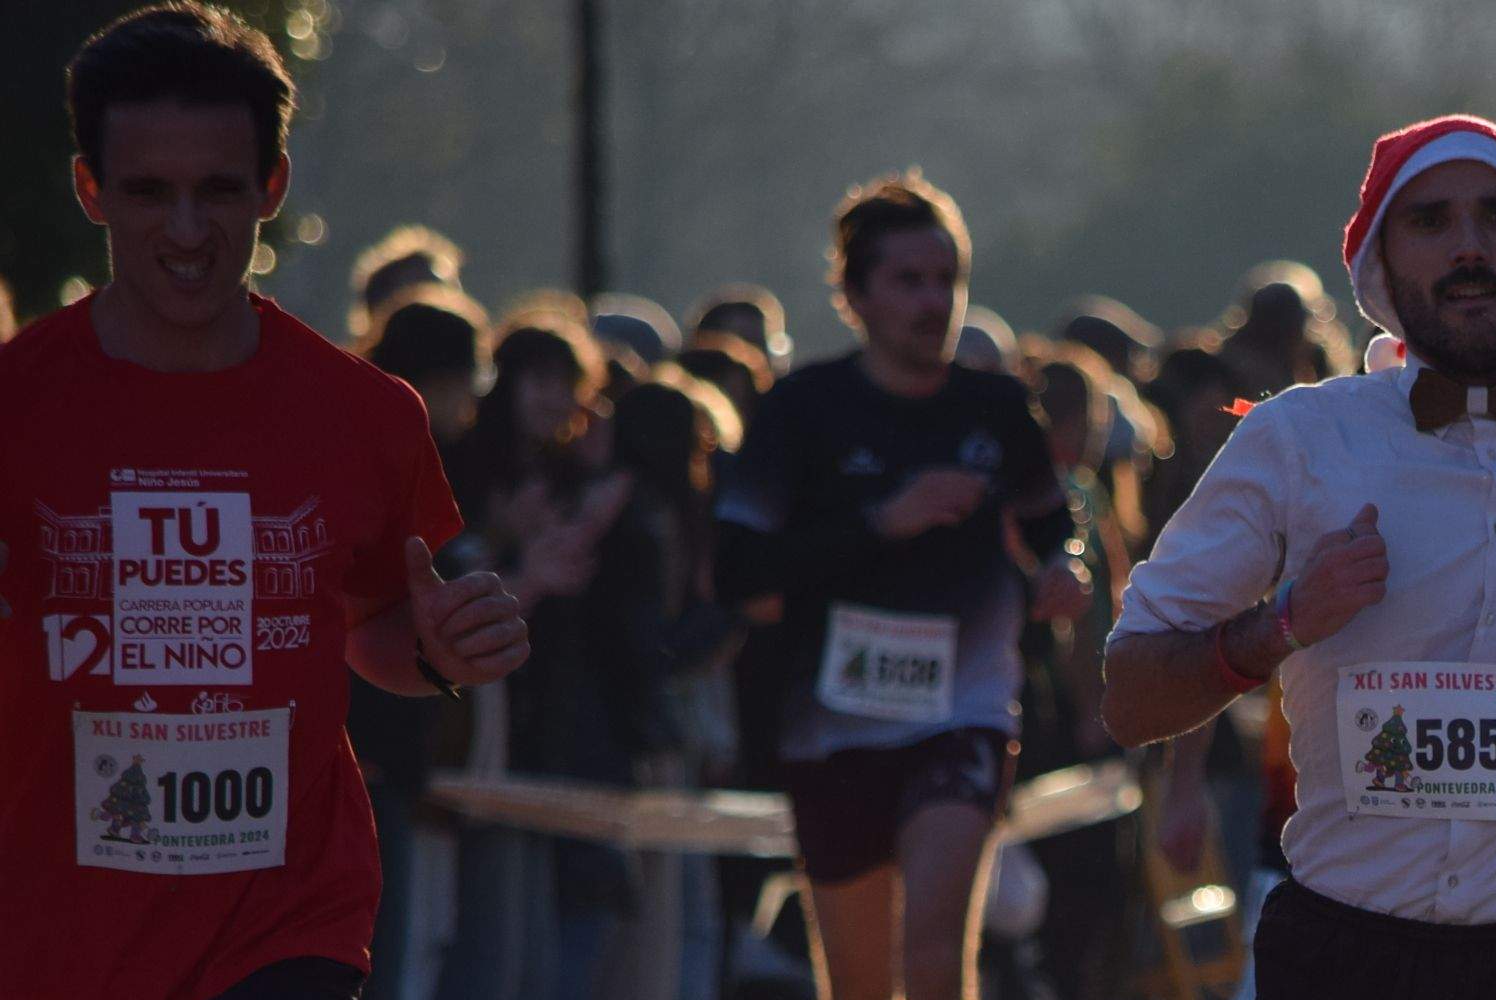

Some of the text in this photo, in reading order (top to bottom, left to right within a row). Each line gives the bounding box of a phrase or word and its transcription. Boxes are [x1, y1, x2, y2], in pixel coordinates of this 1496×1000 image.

[139, 501, 221, 557] TÚ
[119, 559, 247, 587] PUEDES
[119, 599, 244, 612] CARRERA POPULAR
[120, 616, 242, 635] CORRE POR
[256, 624, 311, 651] 2024
[42, 613, 112, 682] 12
[121, 636, 246, 670] EL NIÑO
[1354, 671, 1382, 690] XLI
[1389, 672, 1427, 690] SAN
[92, 719, 271, 742] XLI SAN SILVESTRE
[157, 765, 274, 825] 1000
[1416, 782, 1496, 795] PONTEVEDRA
[154, 829, 270, 848] PONTEVEDRA 2024
